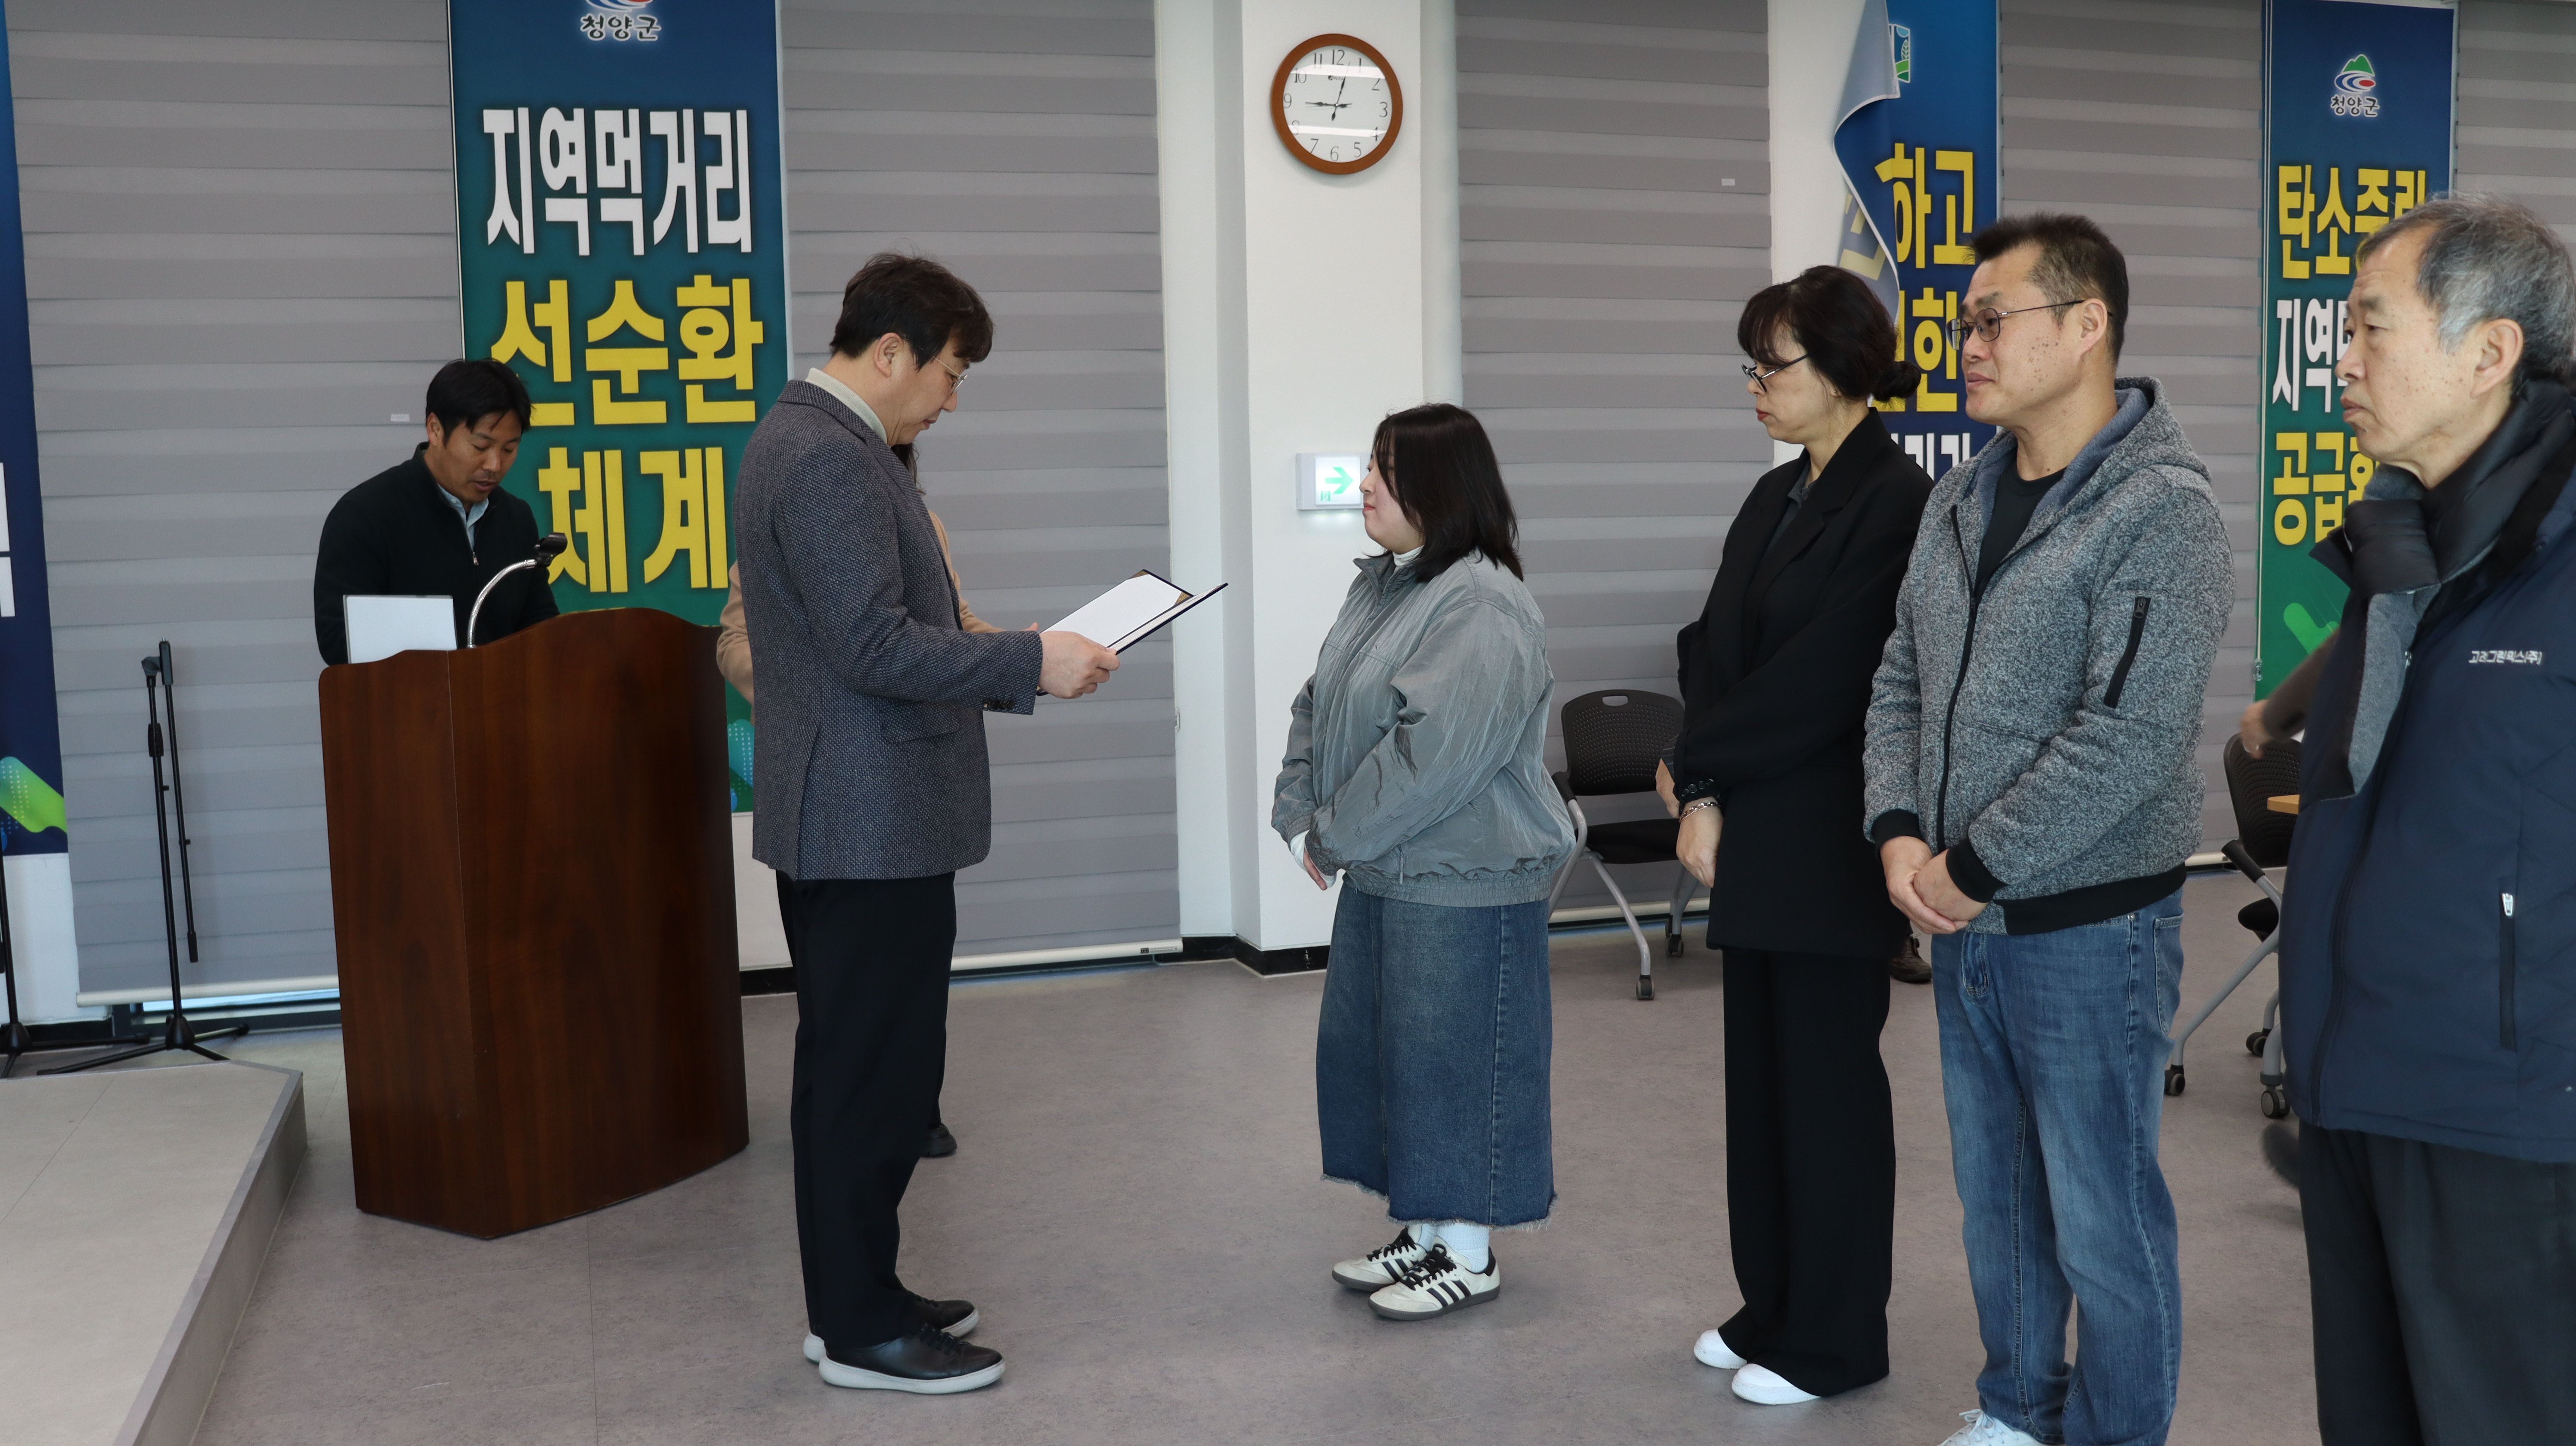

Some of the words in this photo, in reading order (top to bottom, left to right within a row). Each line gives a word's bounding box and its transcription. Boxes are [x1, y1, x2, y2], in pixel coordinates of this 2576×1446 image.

[581, 14, 661, 40] 청양군
[1313, 53, 1322, 68] 11
[1331, 49, 1345, 65] 12
[1358, 58, 1362, 73] 1
[1294, 68, 1306, 83] 10
[1372, 74, 1380, 91] 2
[1283, 94, 1292, 108] 9
[2331, 95, 2380, 117] 청양군
[1379, 102, 1388, 117] 3
[1291, 120, 1299, 136] 8
[1370, 126, 1379, 142] 4
[1310, 138, 1319, 154] 7
[1331, 146, 1339, 161] 6
[1354, 142, 1361, 158] 5
[483, 107, 752, 256] 지역먹거리
[1874, 143, 1975, 268] 하고
[491, 275, 764, 425] 선순환
[538, 447, 729, 593] 체계
